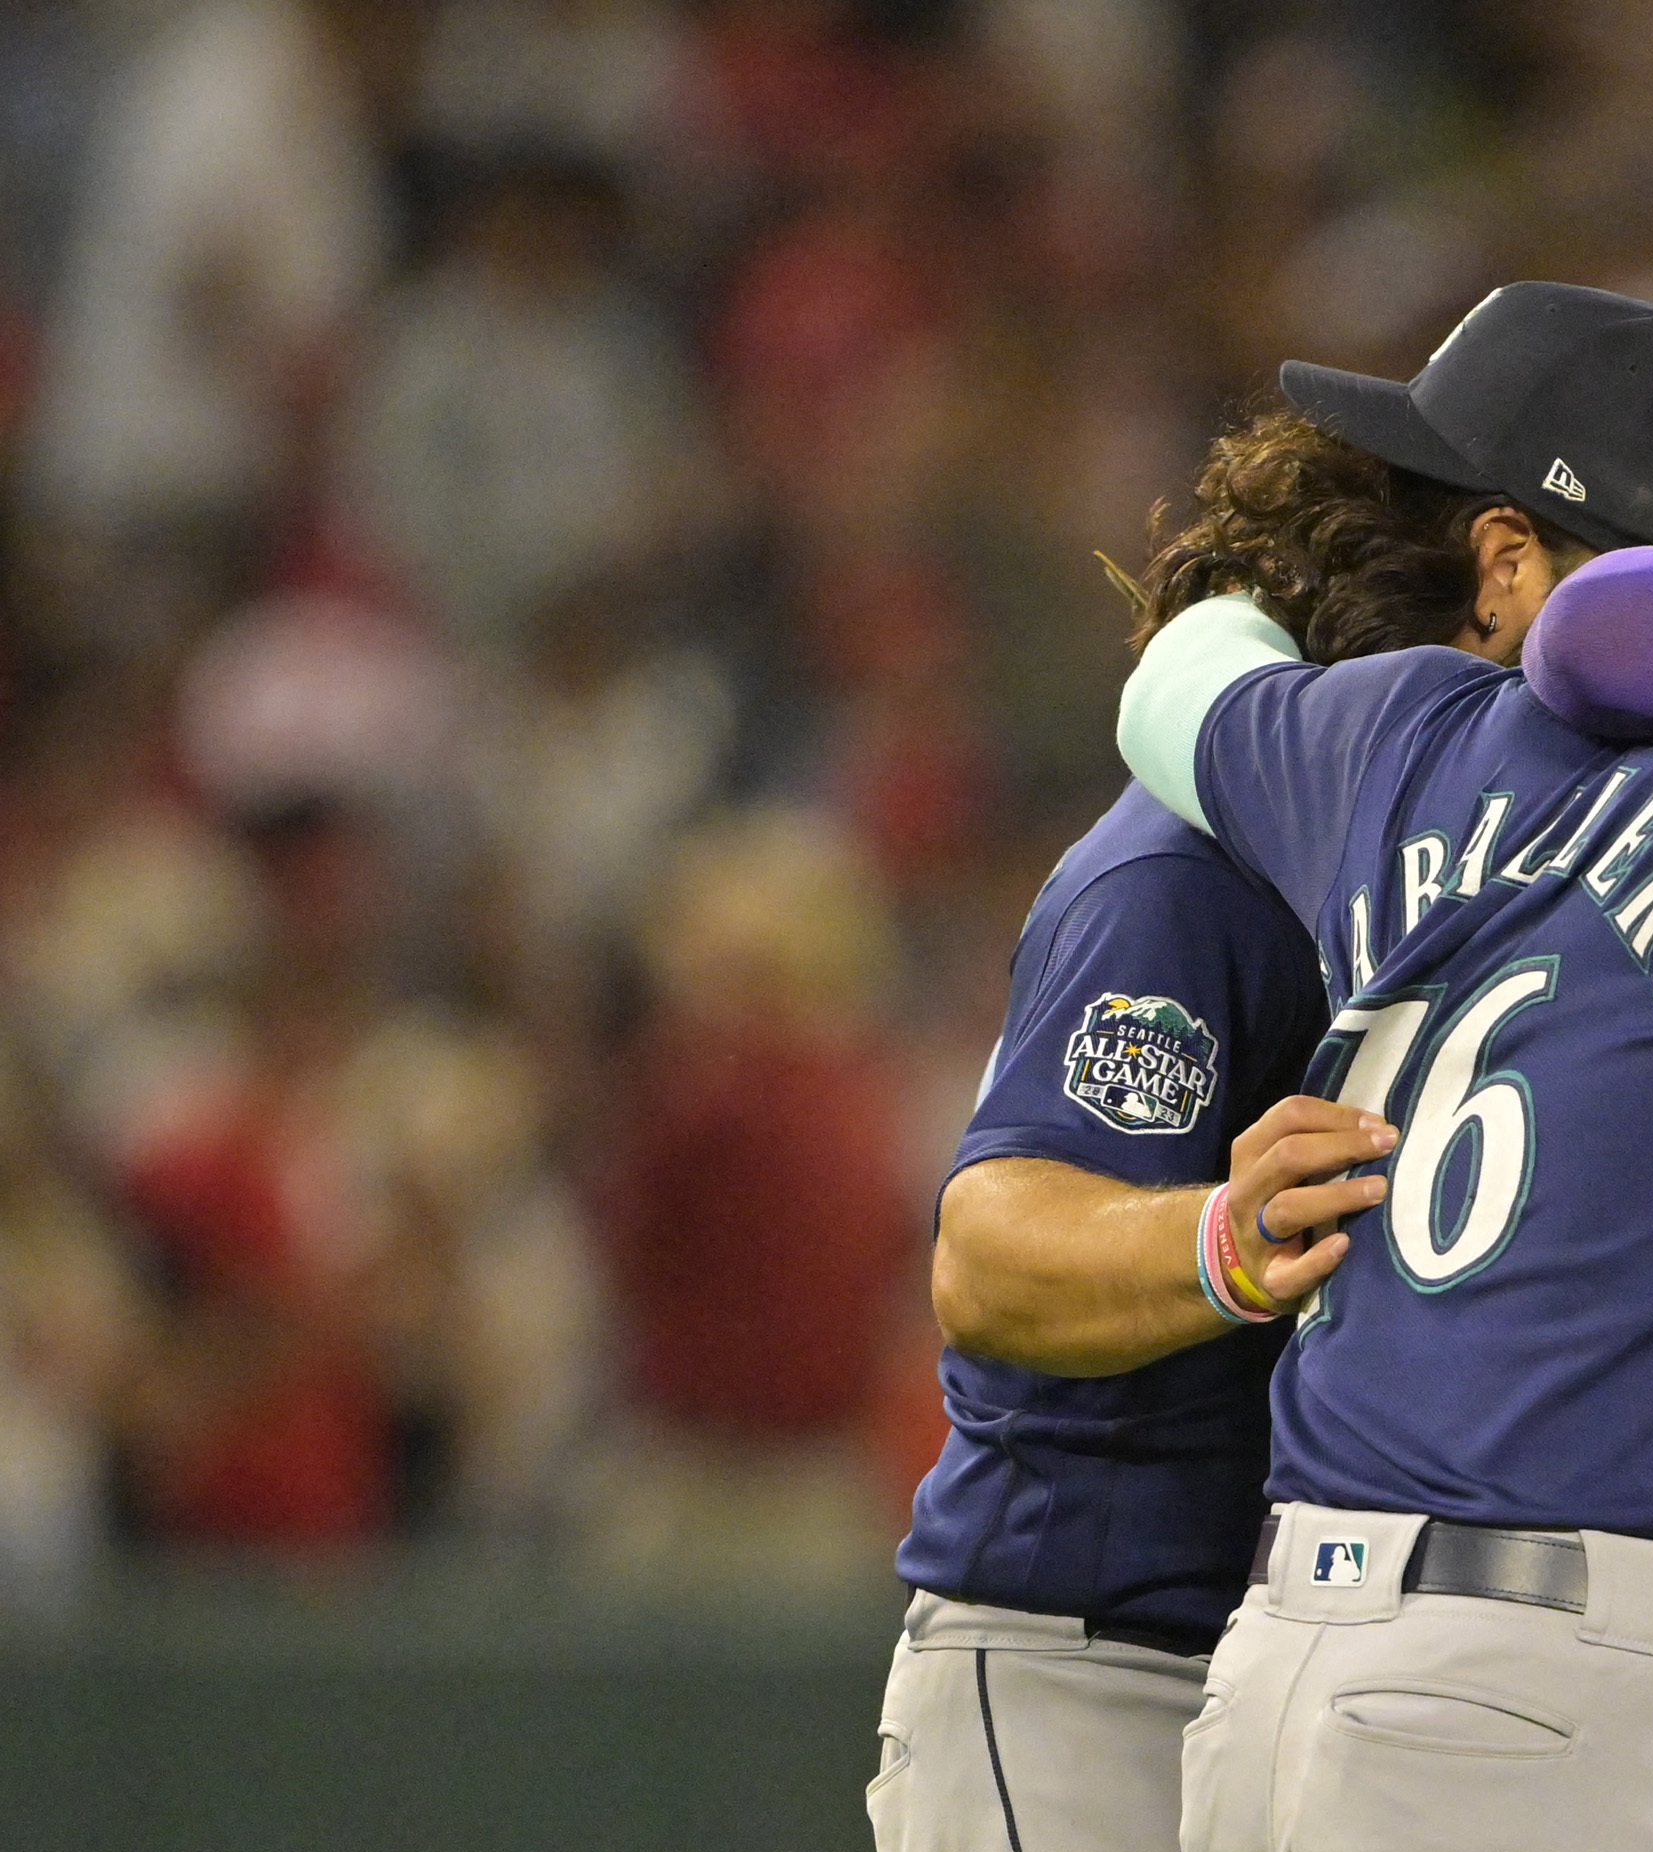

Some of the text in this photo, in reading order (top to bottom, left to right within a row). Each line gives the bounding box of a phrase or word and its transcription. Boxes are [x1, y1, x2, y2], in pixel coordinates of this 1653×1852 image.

[1117, 1024, 1182, 1054] SEATTLE
[1092, 1060, 1180, 1104] GAME
[1160, 1108, 1175, 1122] 23
